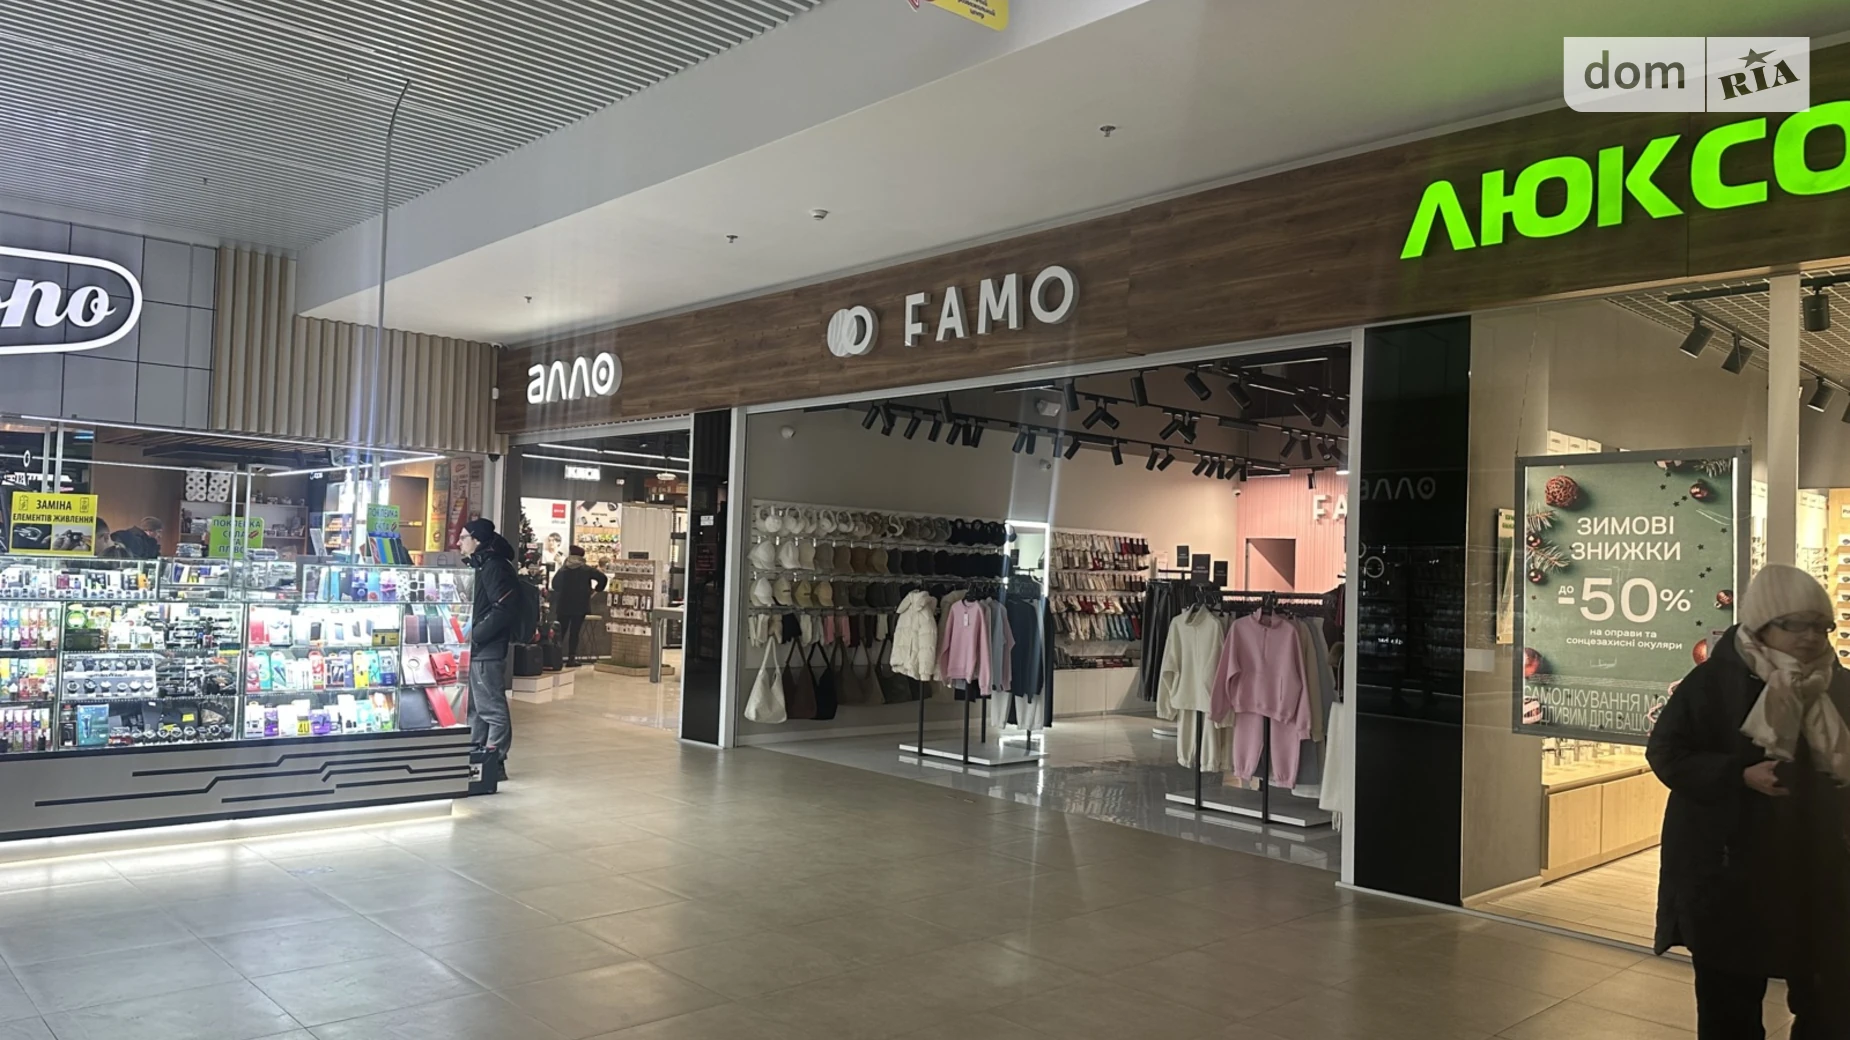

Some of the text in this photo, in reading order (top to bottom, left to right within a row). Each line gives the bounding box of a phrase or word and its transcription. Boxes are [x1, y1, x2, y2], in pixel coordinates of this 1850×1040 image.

[904, 265, 1080, 347] FAMO
[36, 499, 72, 510] ЗАМІНА
[13, 513, 94, 524] ЕЛЕМЕНТІВ ЖИВЛЕННЯ
[1577, 516, 1674, 536] ЗИМОВІ
[1571, 541, 1681, 561] ЗНИЖКИ
[1589, 628, 1602, 636] на
[1604, 629, 1643, 639] оправи
[1566, 637, 1683, 650] сонцезахисні окуляри
[1589, 709, 1613, 731] ДЛЯ
